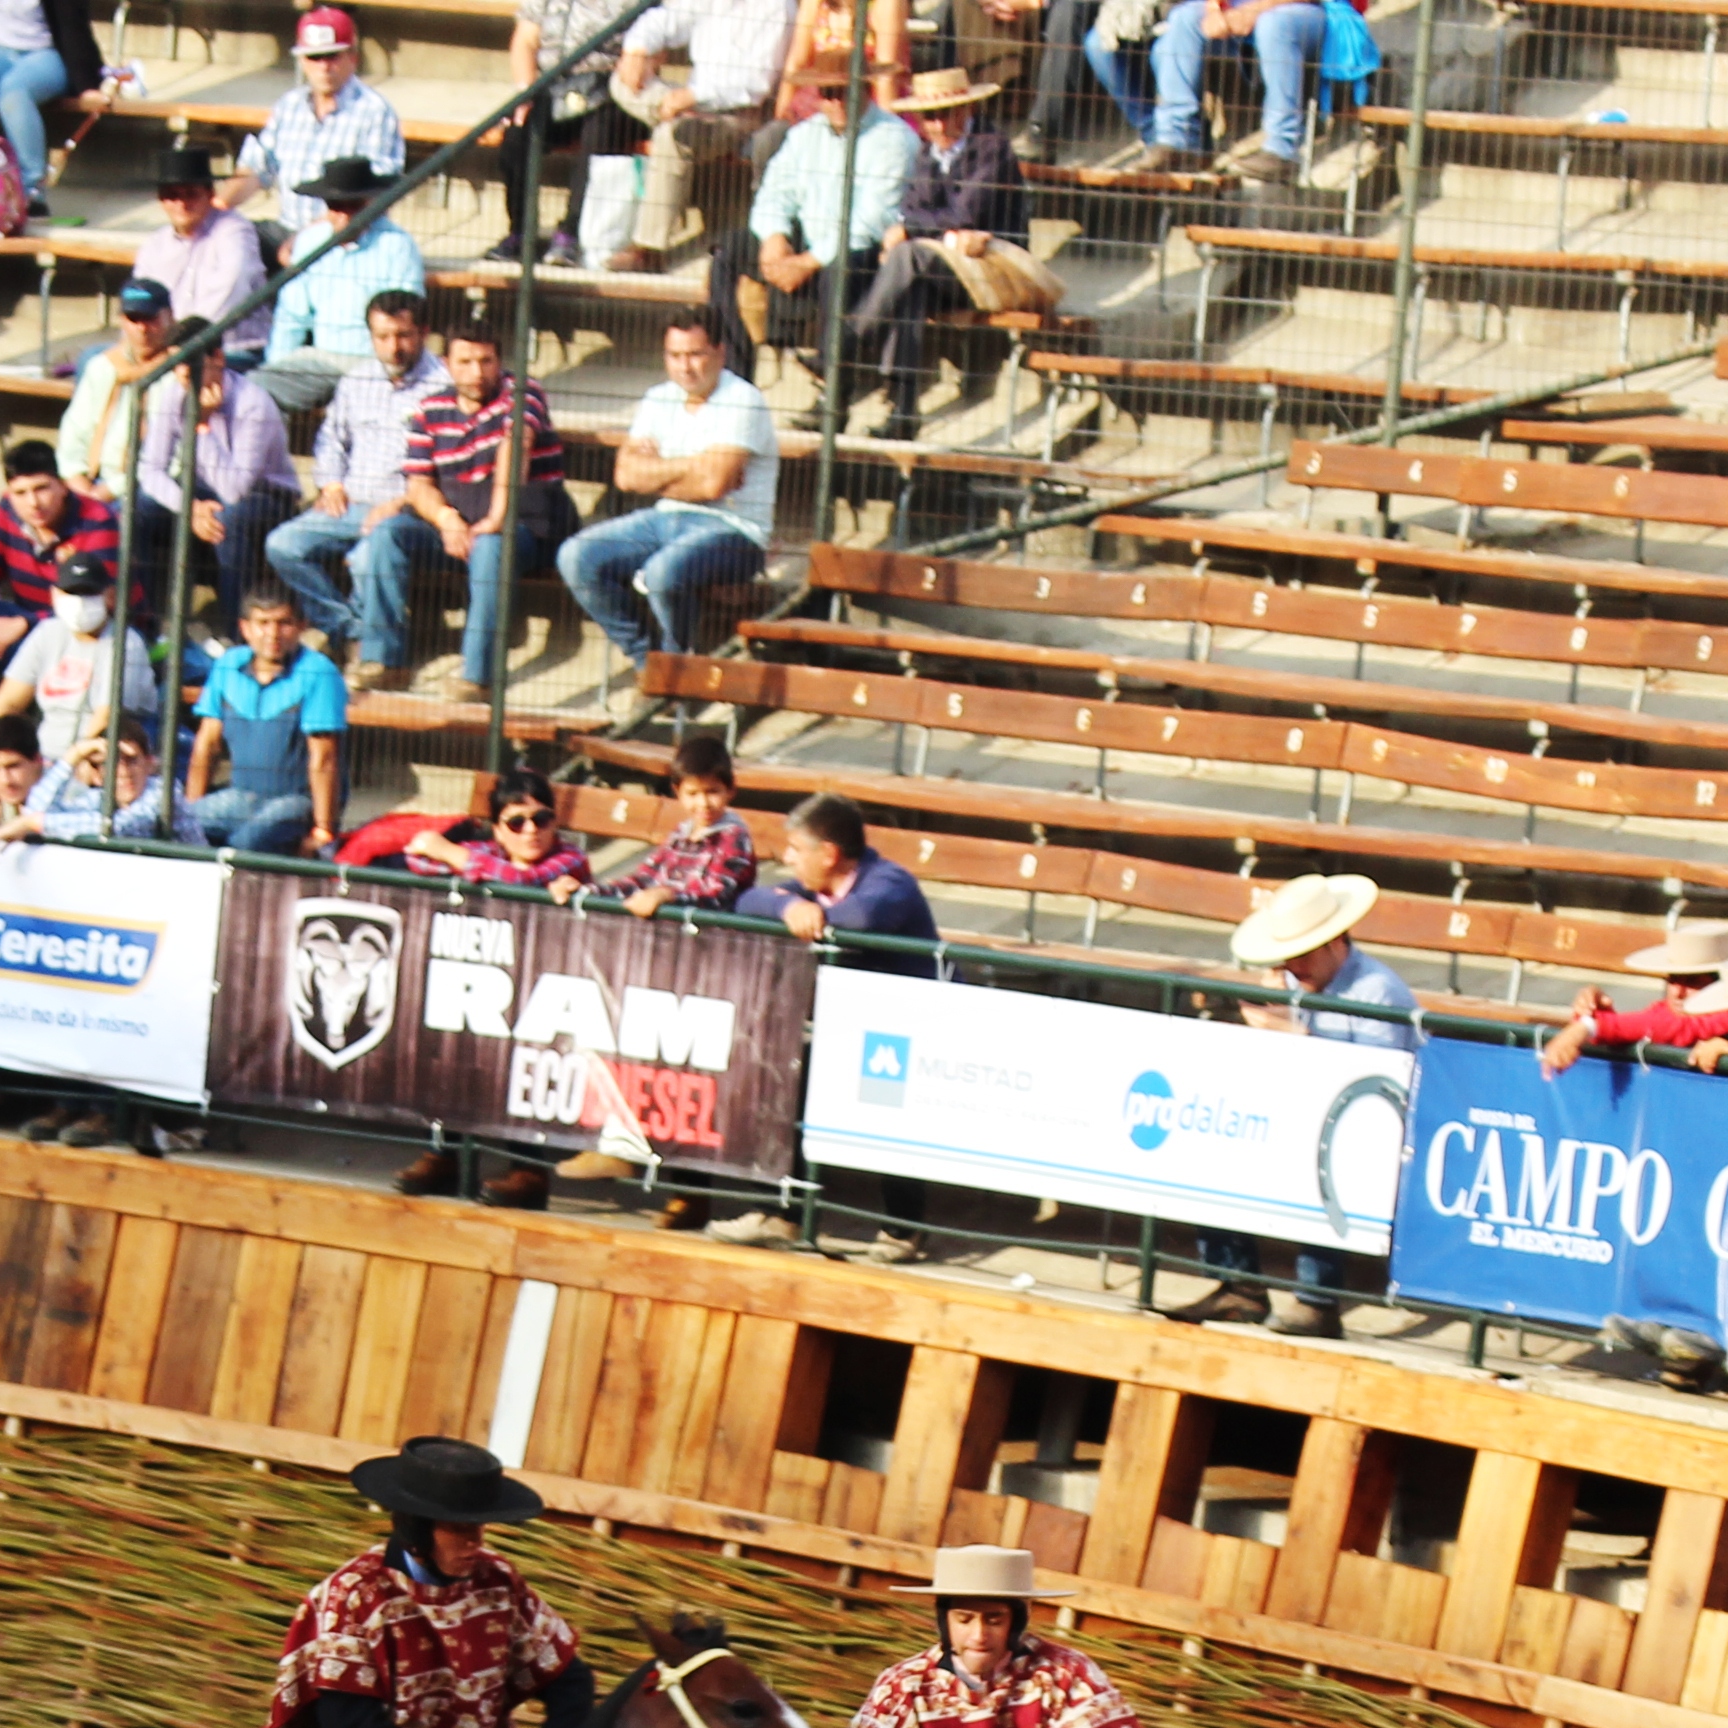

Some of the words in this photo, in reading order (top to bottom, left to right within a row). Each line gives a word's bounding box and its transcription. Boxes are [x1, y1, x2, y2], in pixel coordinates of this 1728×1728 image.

[1306, 452, 1321, 474] 3
[922, 567, 936, 590] 2
[1036, 577, 1051, 598] 3
[1253, 591, 1268, 616] 5
[1460, 613, 1477, 635] 7
[1697, 636, 1712, 660] 9
[947, 693, 962, 717] 5
[1162, 716, 1179, 740] 7
[918, 838, 935, 862] 7
[1122, 868, 1136, 890] 9
[430, 911, 515, 967] NUEVA
[31, 1008, 51, 1024] no
[57, 1006, 77, 1027] da
[424, 958, 736, 1073] RAM
[916, 1056, 1034, 1091] MUSTAD
[1425, 1120, 1672, 1246] CAMPO
[1469, 1221, 1500, 1247] EL
[1501, 1225, 1614, 1265] MERCURIO
